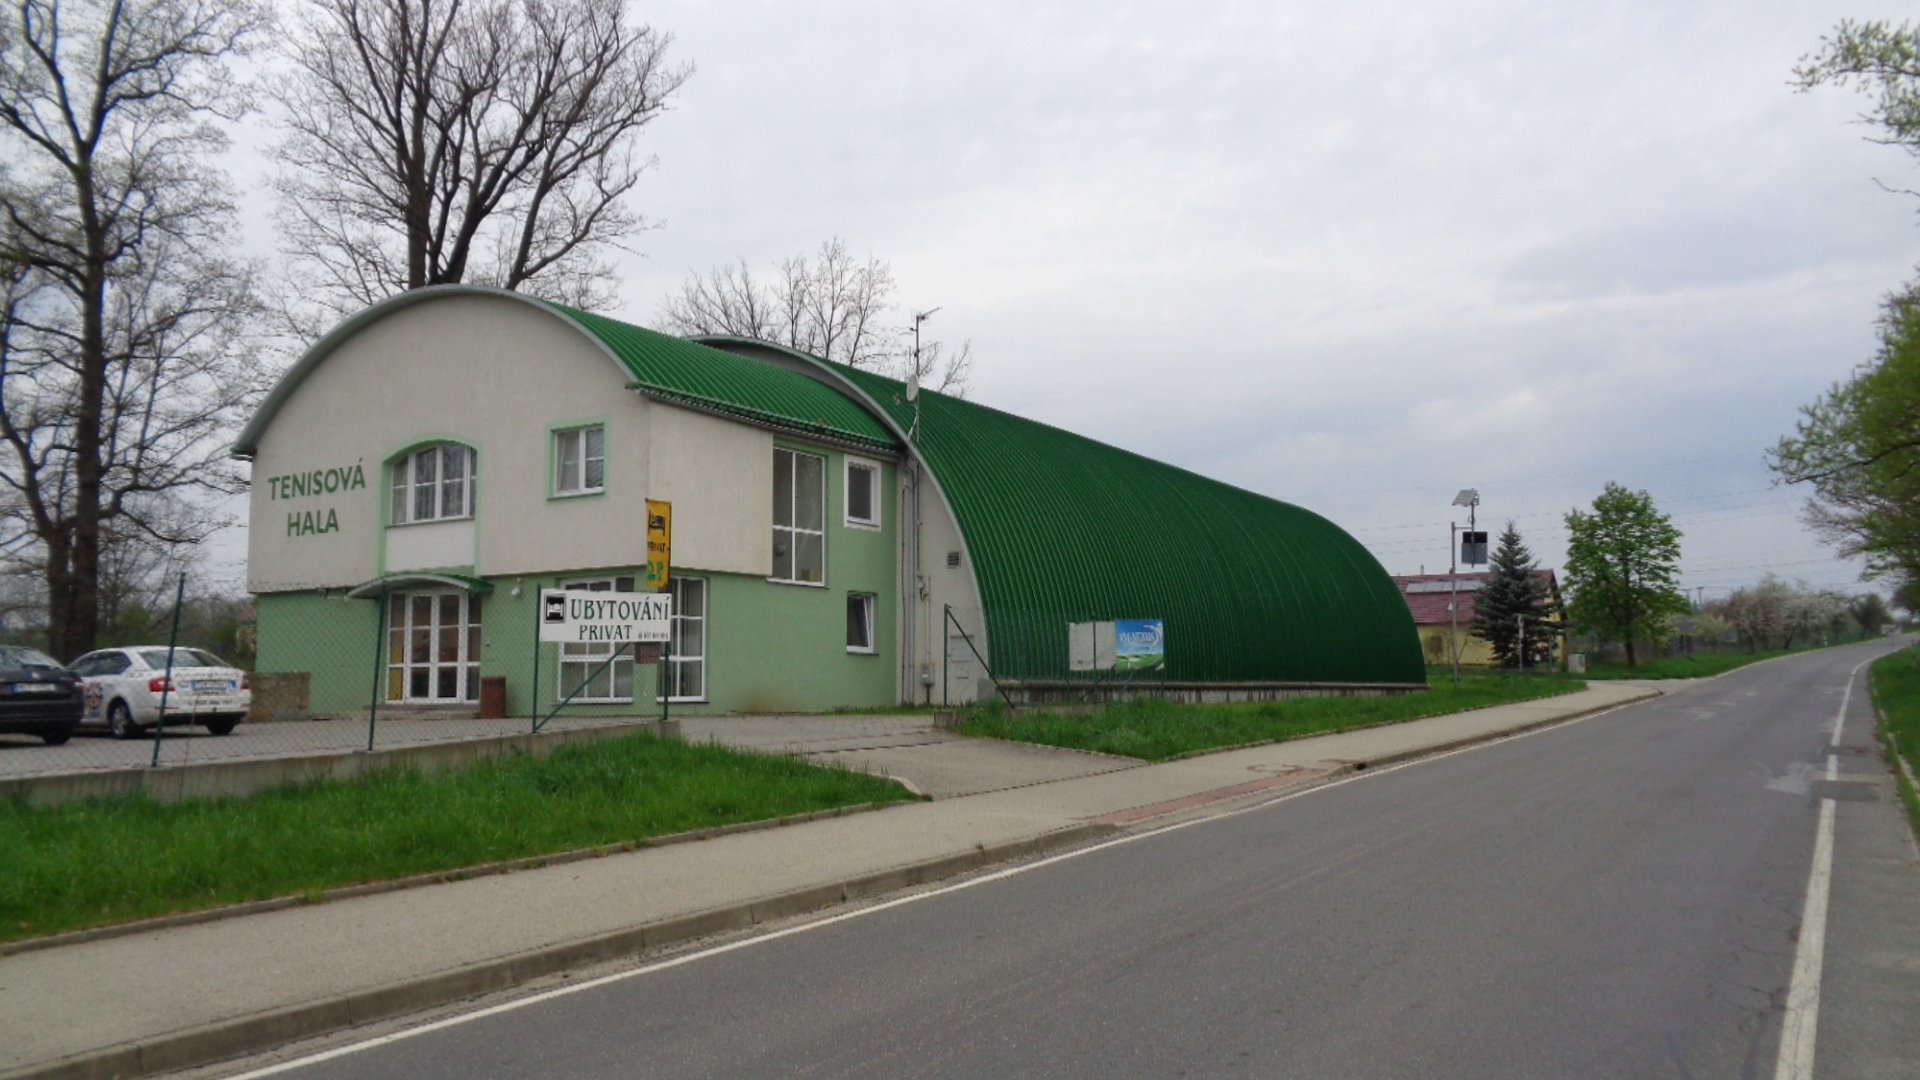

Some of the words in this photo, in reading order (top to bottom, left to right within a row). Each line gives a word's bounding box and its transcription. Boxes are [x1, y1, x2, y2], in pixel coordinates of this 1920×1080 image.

[268, 457, 366, 501] TENISOVÁ
[287, 508, 339, 537] HALA
[570, 596, 670, 621] UBYTOVÁNÍ
[579, 624, 633, 641] PRIVAT
